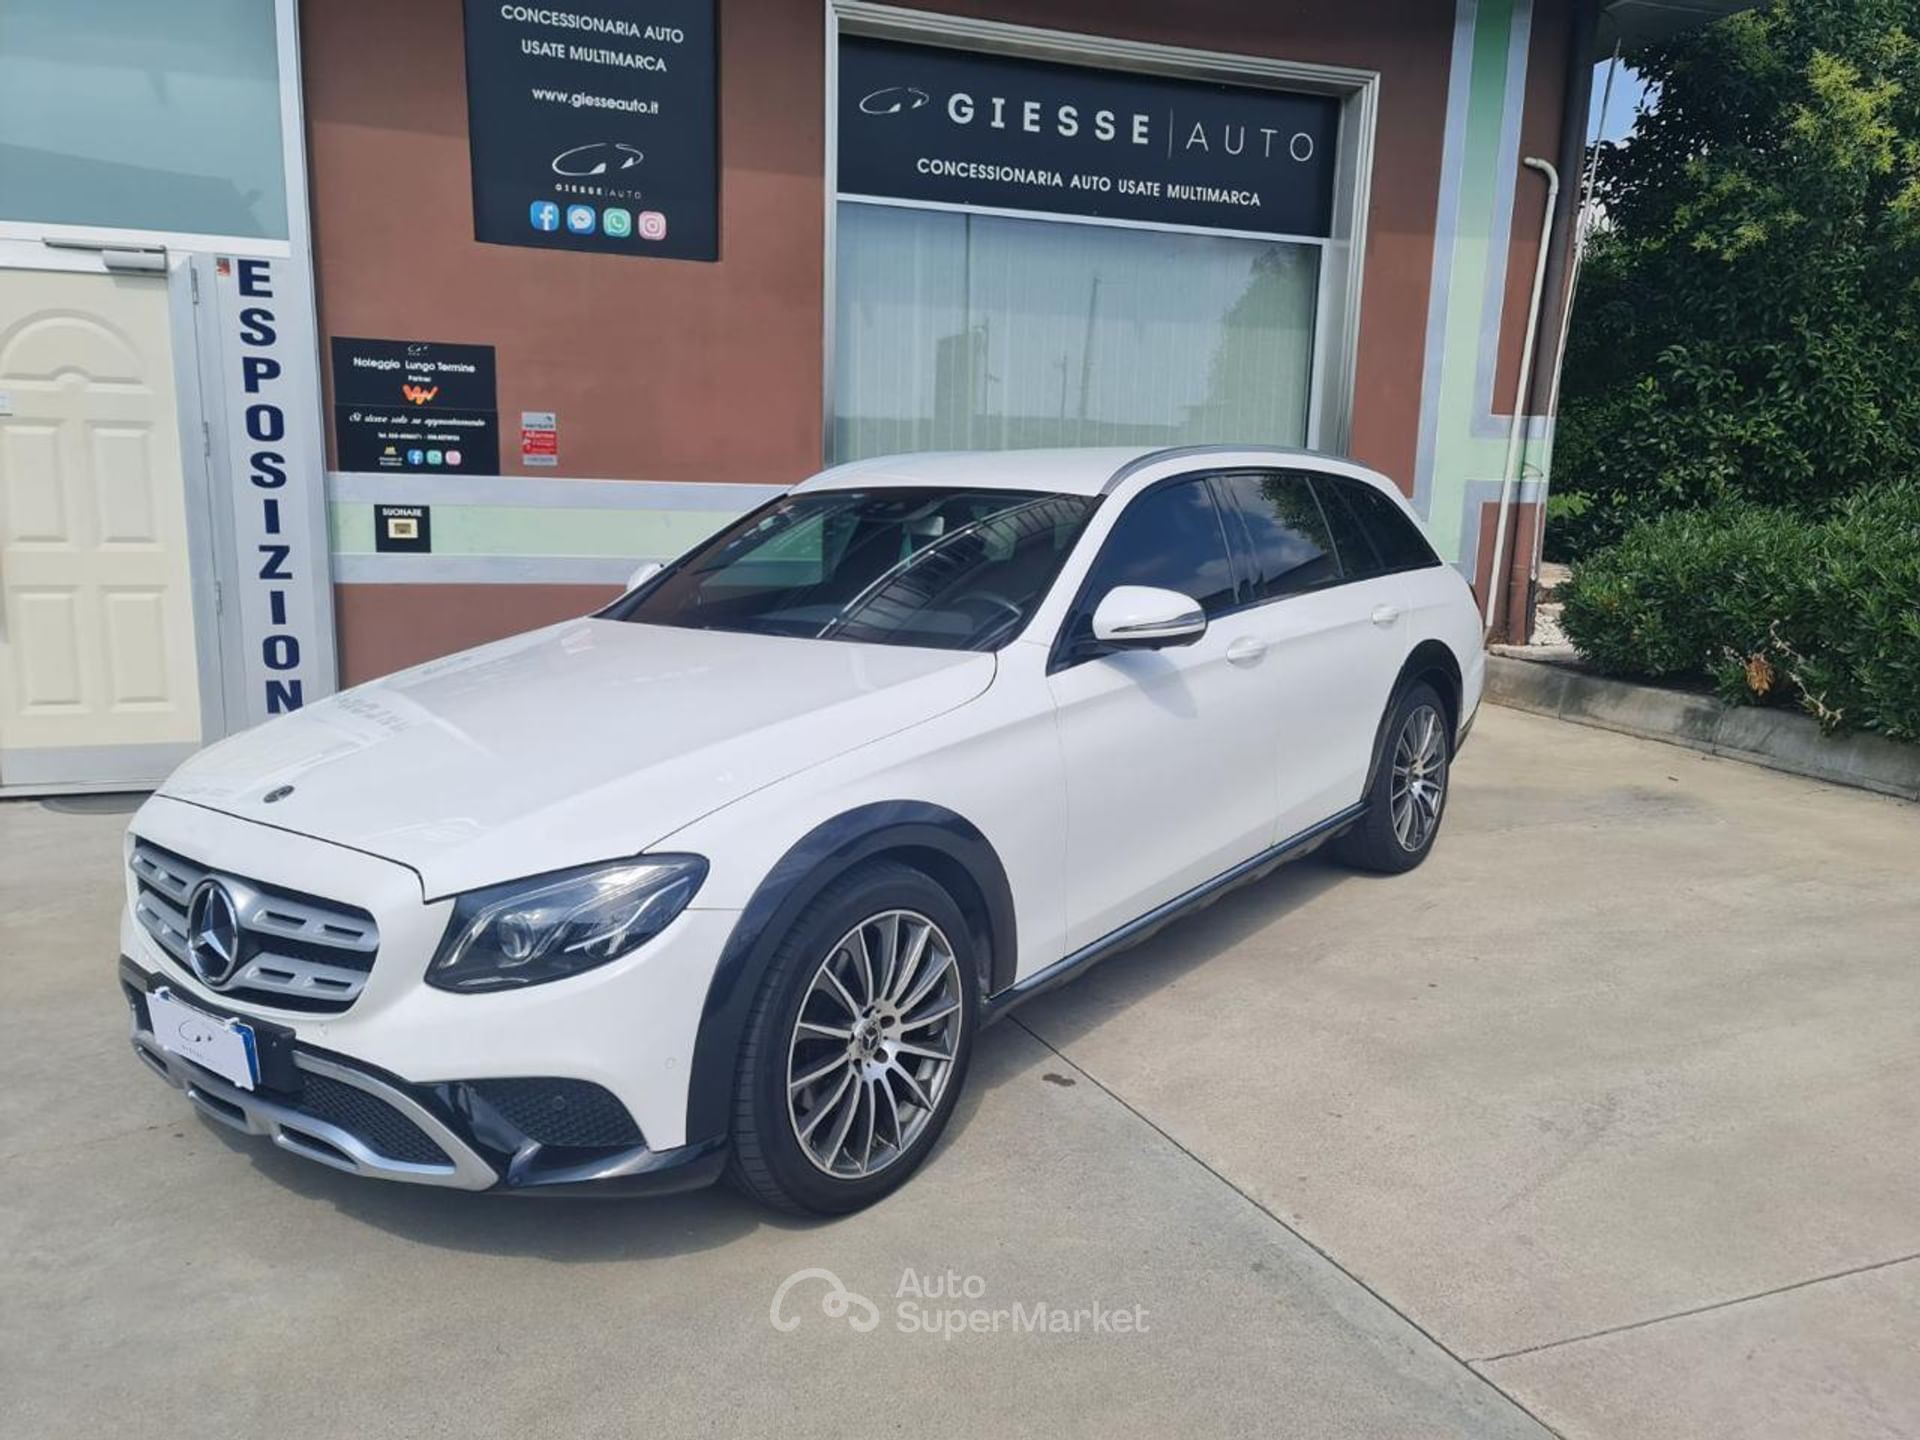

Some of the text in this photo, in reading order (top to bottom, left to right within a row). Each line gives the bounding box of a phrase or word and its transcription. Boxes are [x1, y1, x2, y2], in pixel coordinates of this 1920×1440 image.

[501, 5, 684, 43] CONCESSIONARIA AUTO
[521, 39, 667, 72] USATE MULTIMARCA
[532, 88, 659, 115] www.giesseauto.it
[947, 92, 1314, 162] GIESSE AUTO
[917, 158, 1261, 207] CONCESSIONARIA AUTO USATE MULTIMARCA
[353, 357, 476, 373] Noleggio Lungo Termine
[382, 507, 422, 517] SUONARE
